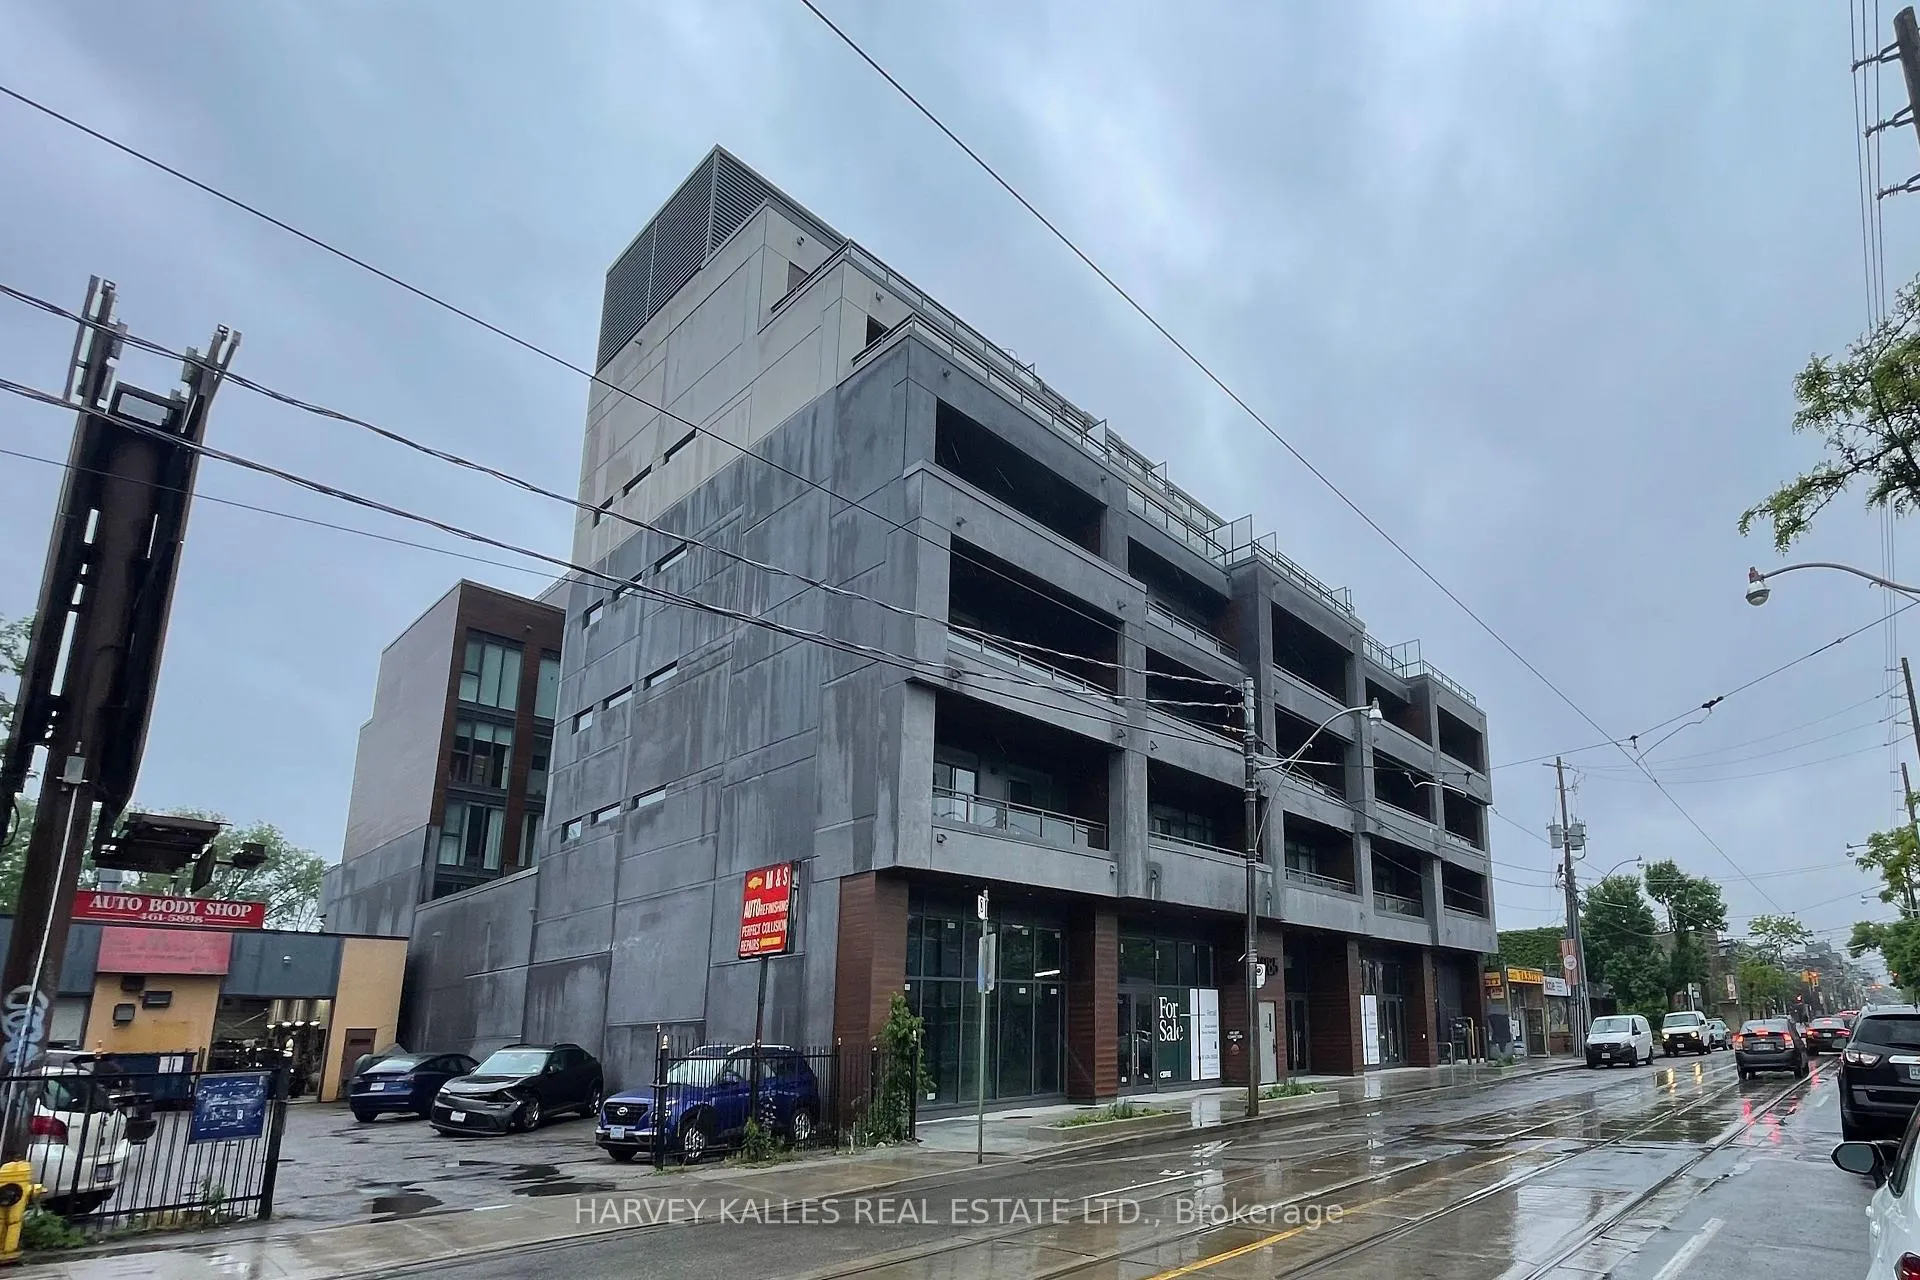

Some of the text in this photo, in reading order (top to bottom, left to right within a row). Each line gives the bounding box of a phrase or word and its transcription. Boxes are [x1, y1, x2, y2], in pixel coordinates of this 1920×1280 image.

[765, 867, 788, 889] M & S
[89, 894, 252, 918] AUTO BODY SHOP
[743, 898, 762, 918] AUTO
[741, 919, 788, 937] PERFECT COLLISION
[740, 939, 759, 951] REPAIRS
[1159, 996, 1178, 1018] For
[1159, 1019, 1183, 1041] Sale
